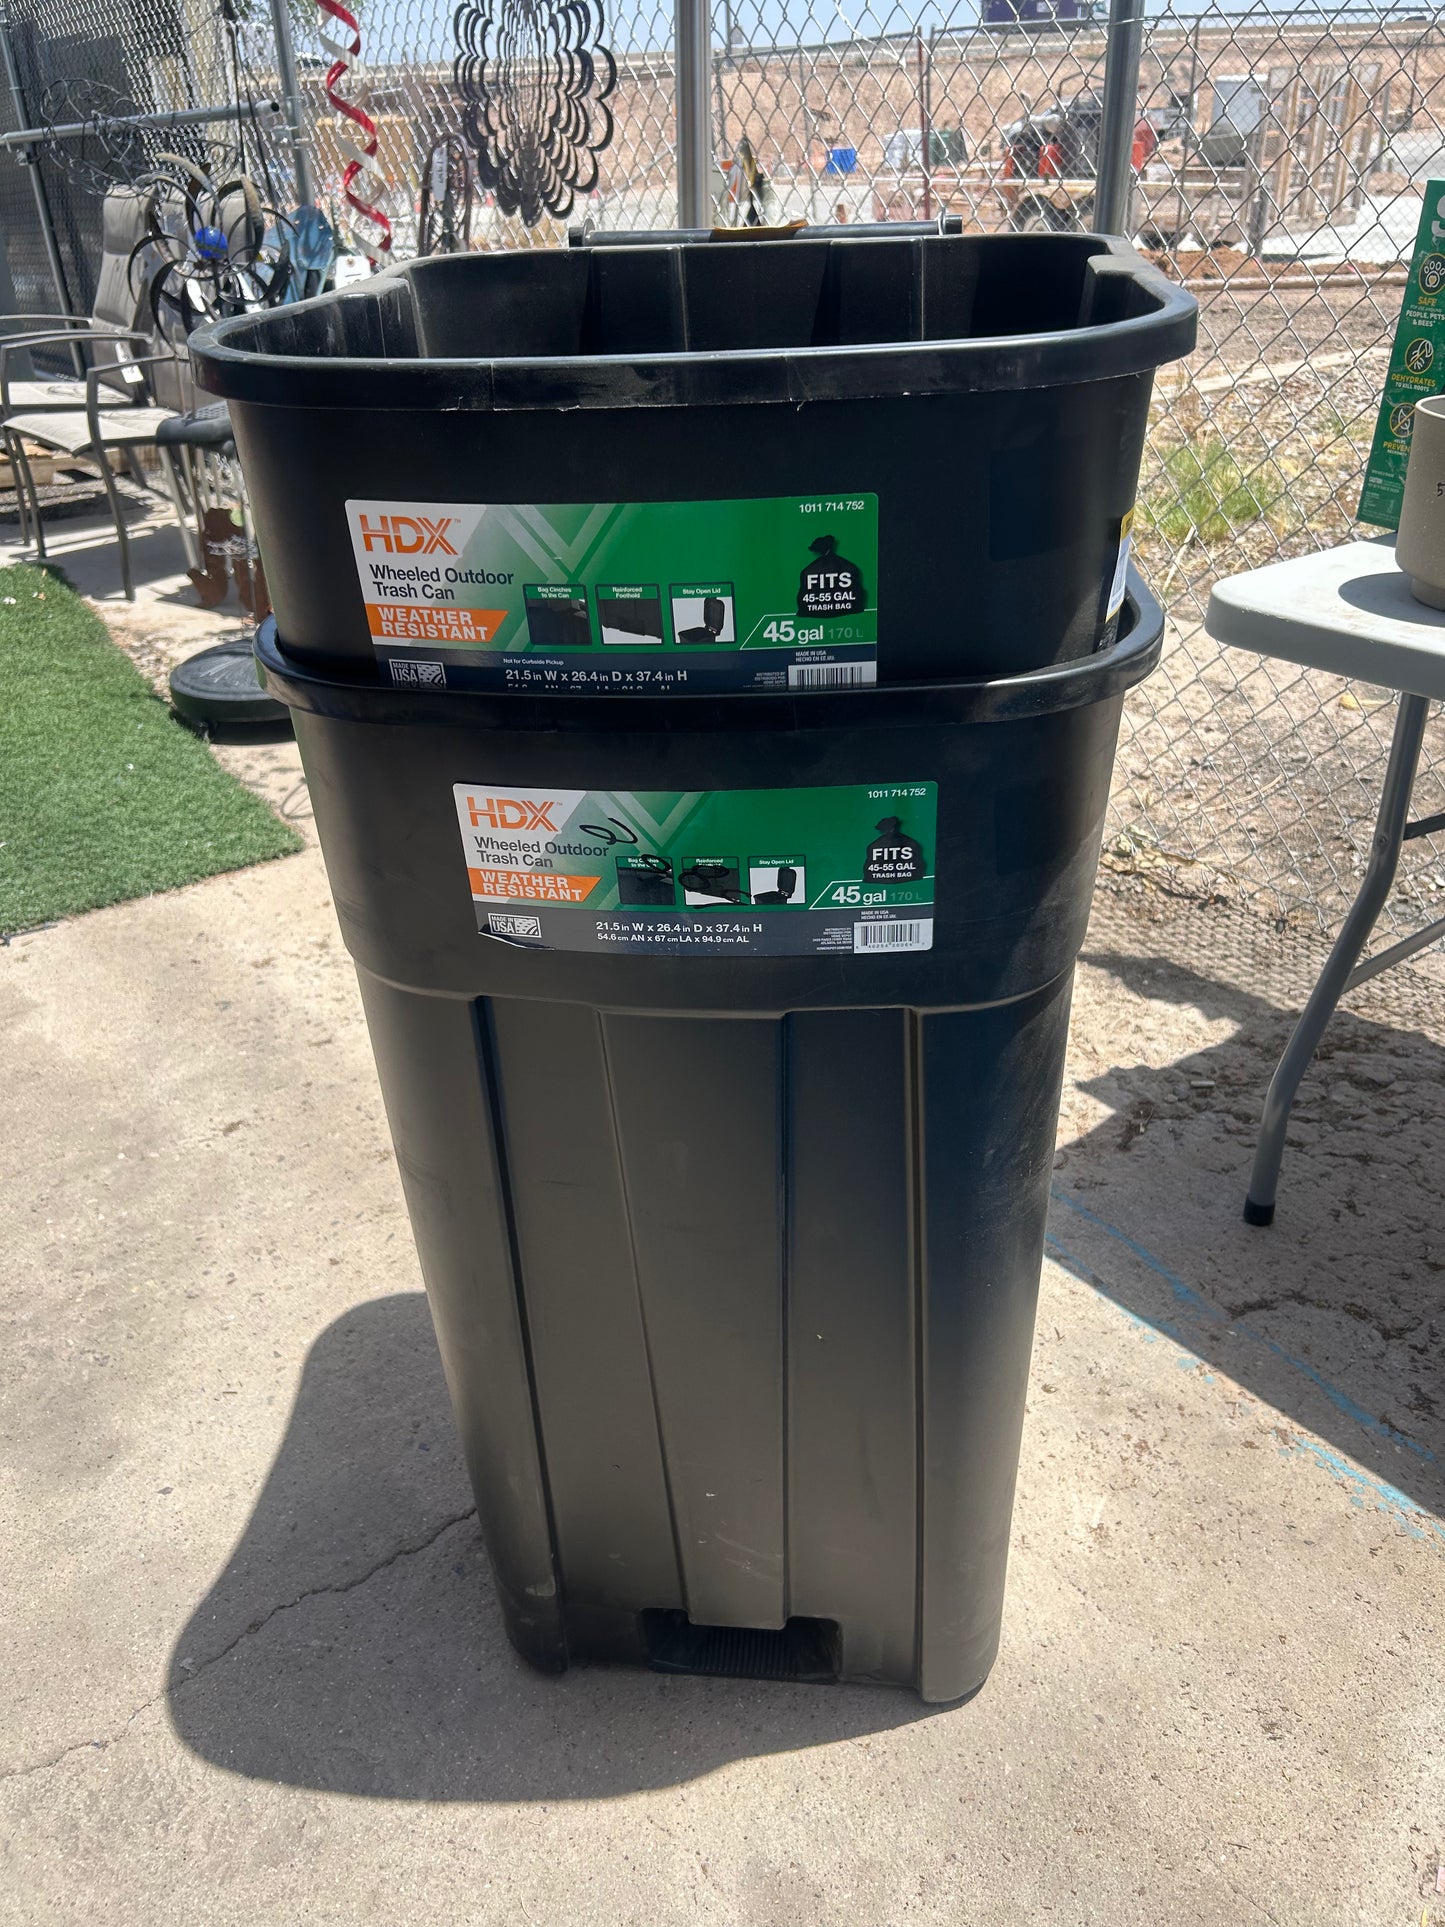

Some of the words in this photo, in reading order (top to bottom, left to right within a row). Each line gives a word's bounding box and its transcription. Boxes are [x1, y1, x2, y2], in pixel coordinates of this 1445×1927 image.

[1418, 296, 1438, 306] SAFE
[1392, 373, 1436, 387] DEHYDRATES
[799, 502, 822, 513] 1011
[825, 502, 844, 512] 714
[846, 501, 864, 511] 752
[369, 564, 440, 583] Wheeled
[445, 567, 514, 585] Outdoor
[807, 572, 852, 590] FITS
[373, 582, 418, 599] Trash
[422, 584, 455, 600] Can
[682, 588, 695, 596] Stay
[696, 588, 710, 596] Open
[803, 593, 832, 603] 45-55
[834, 592, 856, 601] GAL
[807, 604, 834, 612] TRASH
[835, 602, 852, 610] BAG
[377, 607, 473, 626] WEATHER
[382, 622, 487, 640] RESISTANT
[763, 620, 795, 642] 45
[797, 625, 824, 644] gal
[828, 627, 853, 639] 170
[856, 628, 864, 638] L
[394, 668, 418, 682] USA
[505, 669, 532, 681] 21.5
[533, 672, 542, 681] in
[544, 671, 557, 681] W
[561, 673, 569, 681] x
[572, 671, 598, 682] 26.4
[600, 673, 609, 682] in
[612, 672, 622, 682] D
[625, 673, 634, 682] x
[636, 671, 663, 682] 37.4
[665, 672, 674, 681] in
[678, 671, 687, 681] H
[867, 790, 888, 799] 1011
[891, 789, 907, 797] 714
[909, 788, 926, 796] 752
[474, 836, 540, 853] Wheeled
[545, 842, 609, 857] Outdoor
[872, 846, 913, 861] FITS
[476, 850, 520, 865] Trash
[522, 854, 553, 868] Can
[868, 863, 894, 871] 45-55
[895, 862, 916, 870] GAL
[480, 871, 569, 888] WEATHER
[483, 882, 582, 901] RESISTANT
[831, 885, 861, 904] 45
[862, 890, 886, 906] gal
[890, 891, 912, 901] 170
[915, 891, 922, 900] L
[492, 921, 515, 934] USA
[596, 921, 620, 931] 21.5
[631, 922, 645, 932] W
[657, 923, 681, 933] 26.4
[682, 925, 691, 933] in
[694, 924, 703, 933] D
[715, 924, 741, 933] 37.4
[741, 925, 750, 933] in
[753, 924, 762, 932] H
[597, 933, 616, 941] 54.6
[630, 934, 645, 942] AN
[679, 935, 692, 943] LA
[702, 935, 722, 943] 94.9
[736, 935, 749, 943] AL
